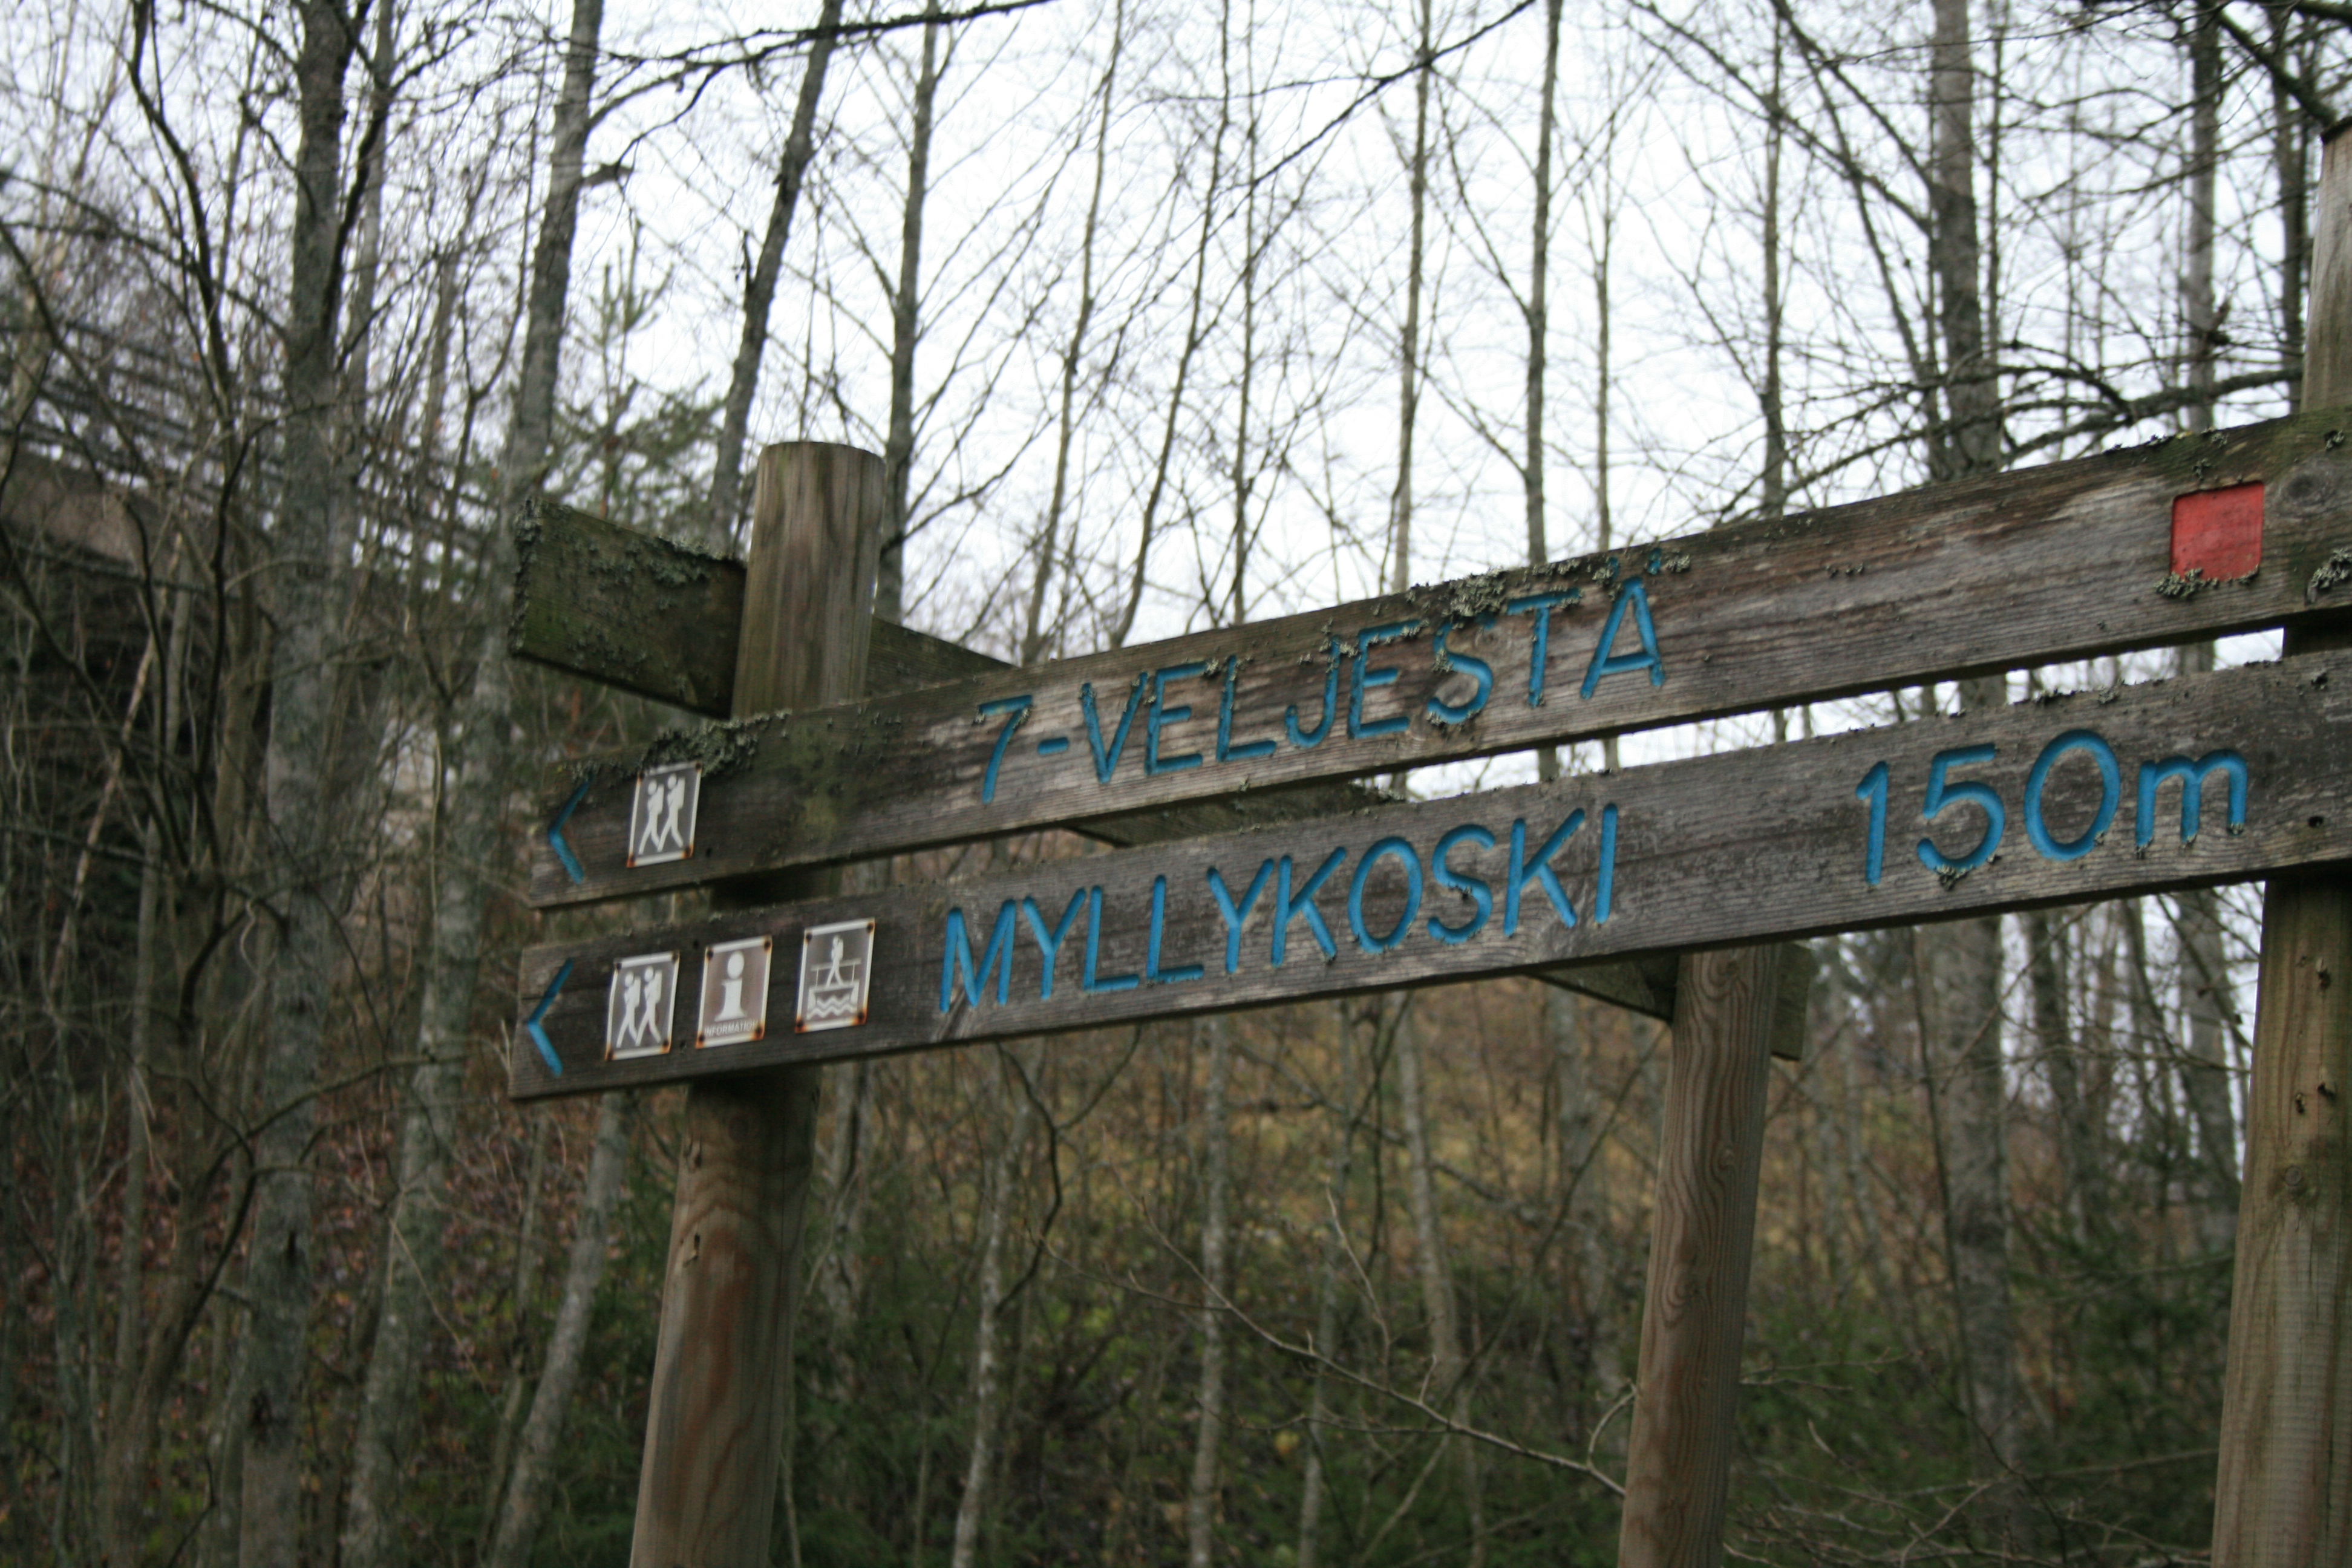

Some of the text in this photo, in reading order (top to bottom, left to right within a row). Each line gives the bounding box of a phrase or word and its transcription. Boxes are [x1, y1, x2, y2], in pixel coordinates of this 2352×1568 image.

[977, 547, 1665, 805] 7-VELJESTÄ
[939, 729, 2247, 1014] MYLLYKOSKI 150m
